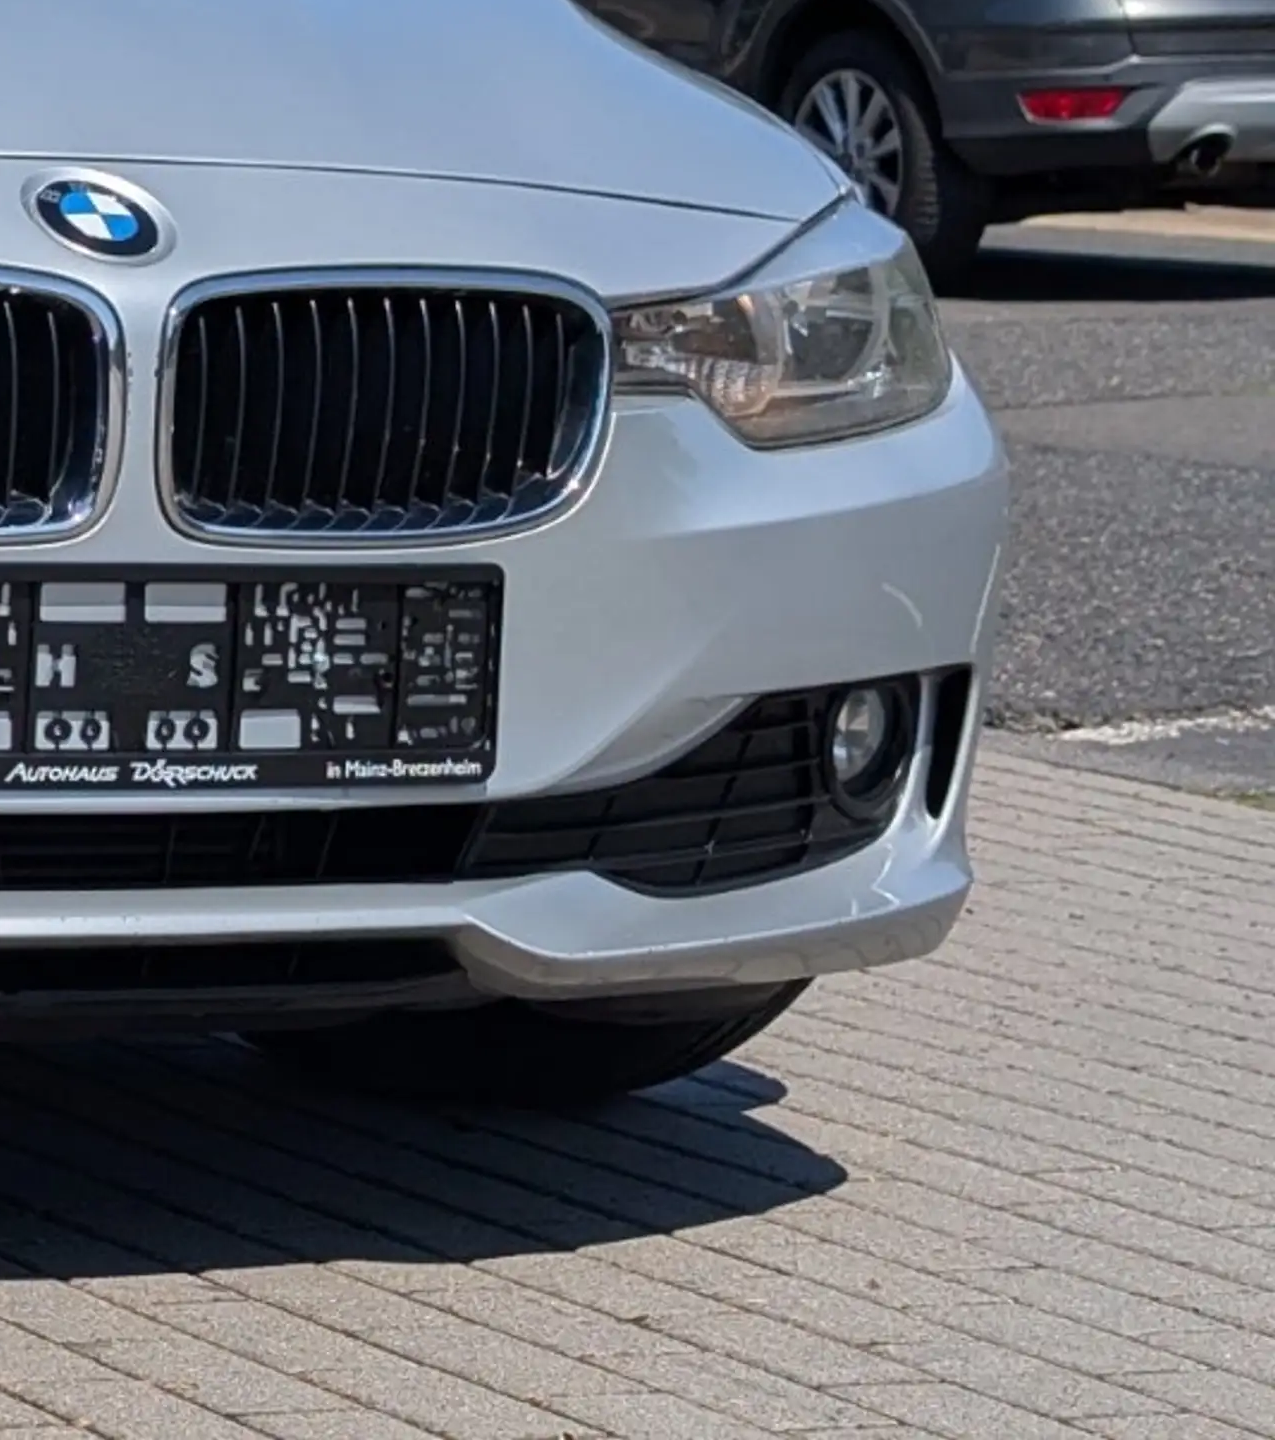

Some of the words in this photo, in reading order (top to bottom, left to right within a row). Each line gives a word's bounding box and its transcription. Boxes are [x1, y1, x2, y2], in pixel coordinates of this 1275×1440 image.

[4, 761, 120, 782] AUTOHAUS
[326, 760, 342, 779] in
[344, 757, 483, 779] Mainz-Bretzenheim
